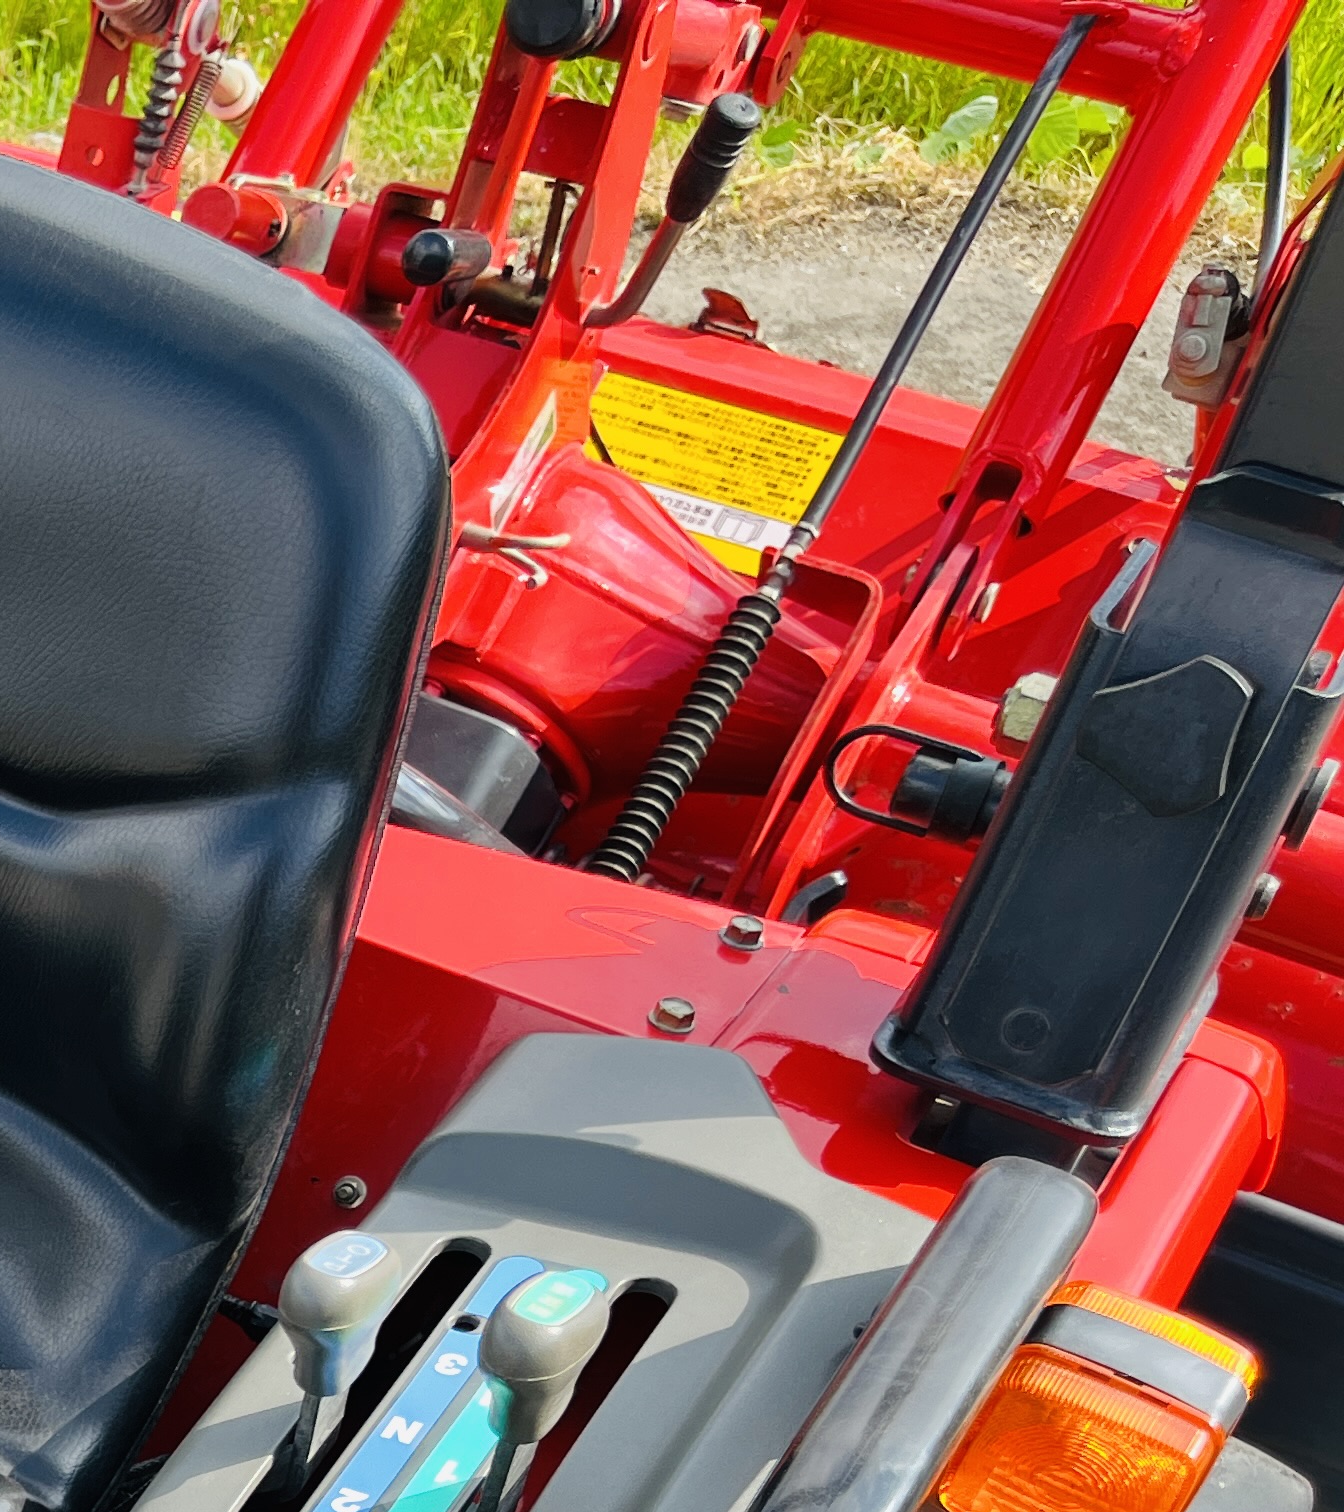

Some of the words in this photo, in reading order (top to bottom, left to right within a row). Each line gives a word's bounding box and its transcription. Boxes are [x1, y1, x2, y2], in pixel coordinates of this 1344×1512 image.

[433, 1352, 468, 1376] 3
[379, 1415, 424, 1445] N
[433, 1459, 459, 1485] 1
